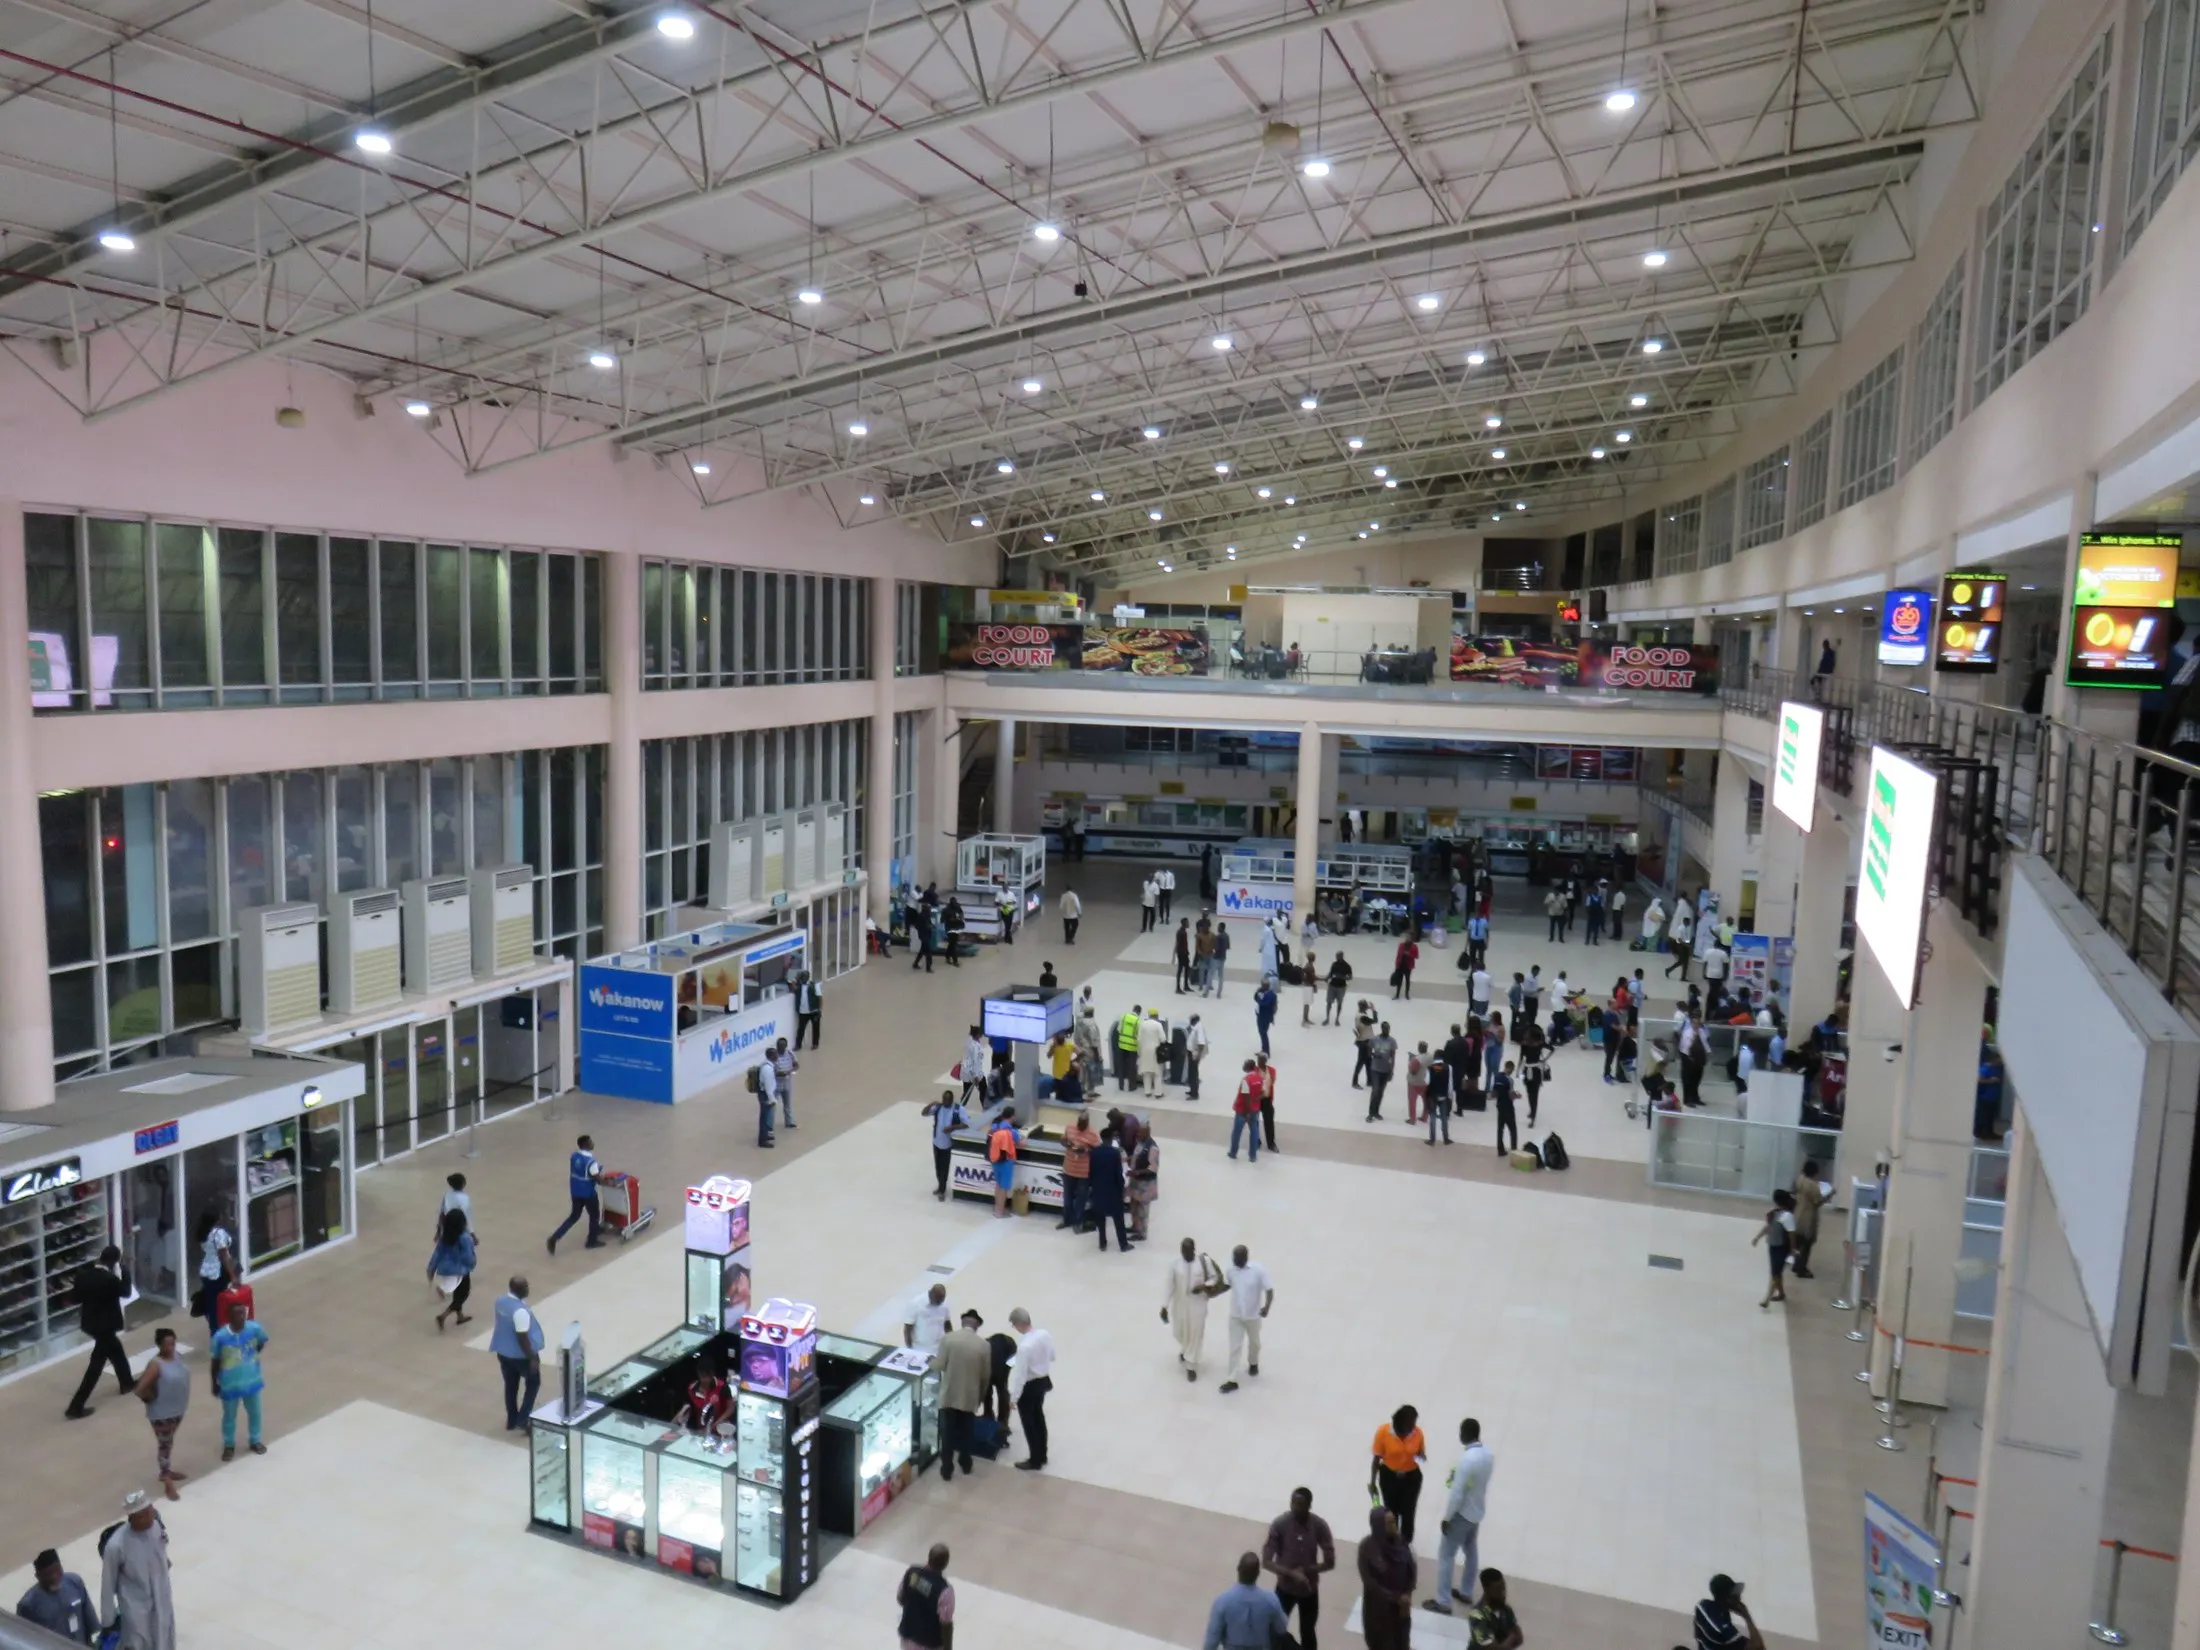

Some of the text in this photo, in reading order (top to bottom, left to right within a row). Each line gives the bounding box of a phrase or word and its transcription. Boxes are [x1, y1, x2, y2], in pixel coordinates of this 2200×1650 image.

[978, 625, 1049, 644] FOOD
[973, 647, 1055, 666] COURT
[1610, 646, 1691, 666] FOOD
[1603, 668, 1695, 688] COURT
[1224, 888, 1294, 910] Wakano
[588, 985, 665, 1012] Wakanow
[709, 1020, 777, 1063] Wakanow
[1884, 1627, 1921, 1648] EXIT
